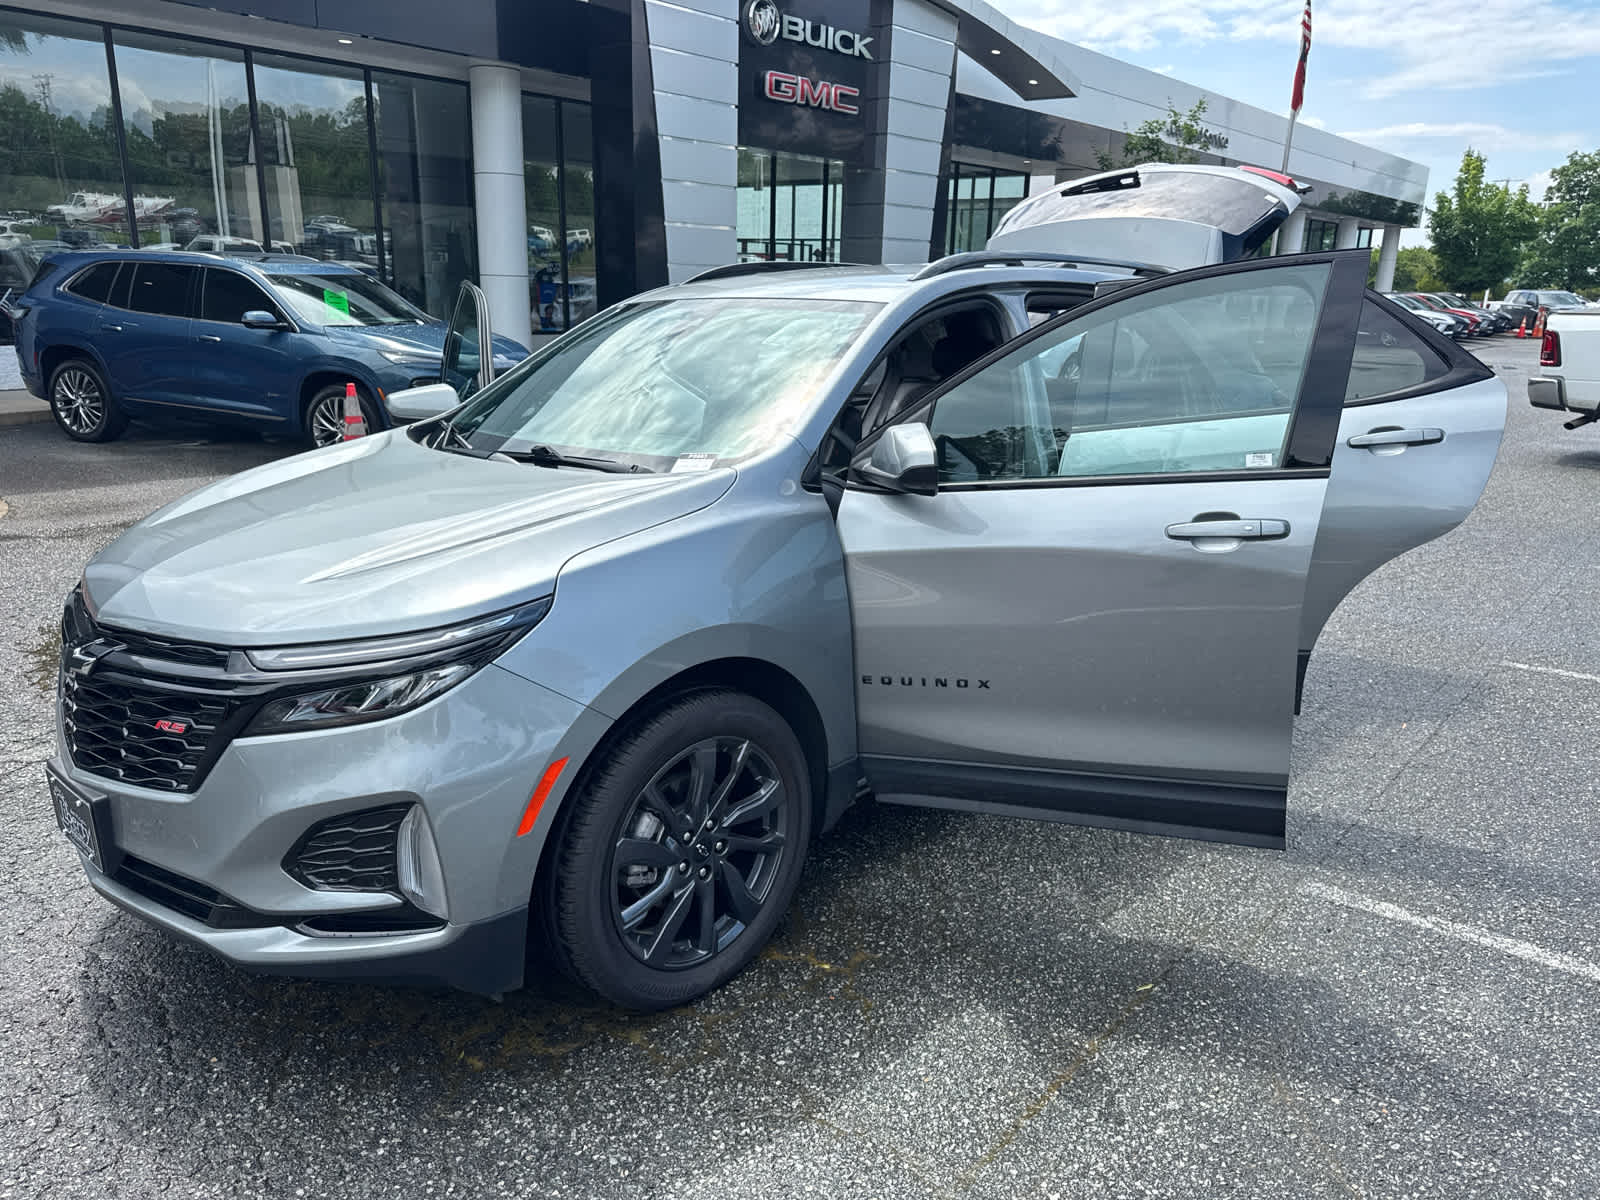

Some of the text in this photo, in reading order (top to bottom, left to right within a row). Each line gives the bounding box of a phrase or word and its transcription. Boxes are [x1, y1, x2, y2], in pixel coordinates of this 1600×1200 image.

[782, 14, 874, 60] BUICK
[765, 70, 860, 115] GMC
[861, 675, 991, 689] EQUINOX
[155, 719, 186, 733] RS
